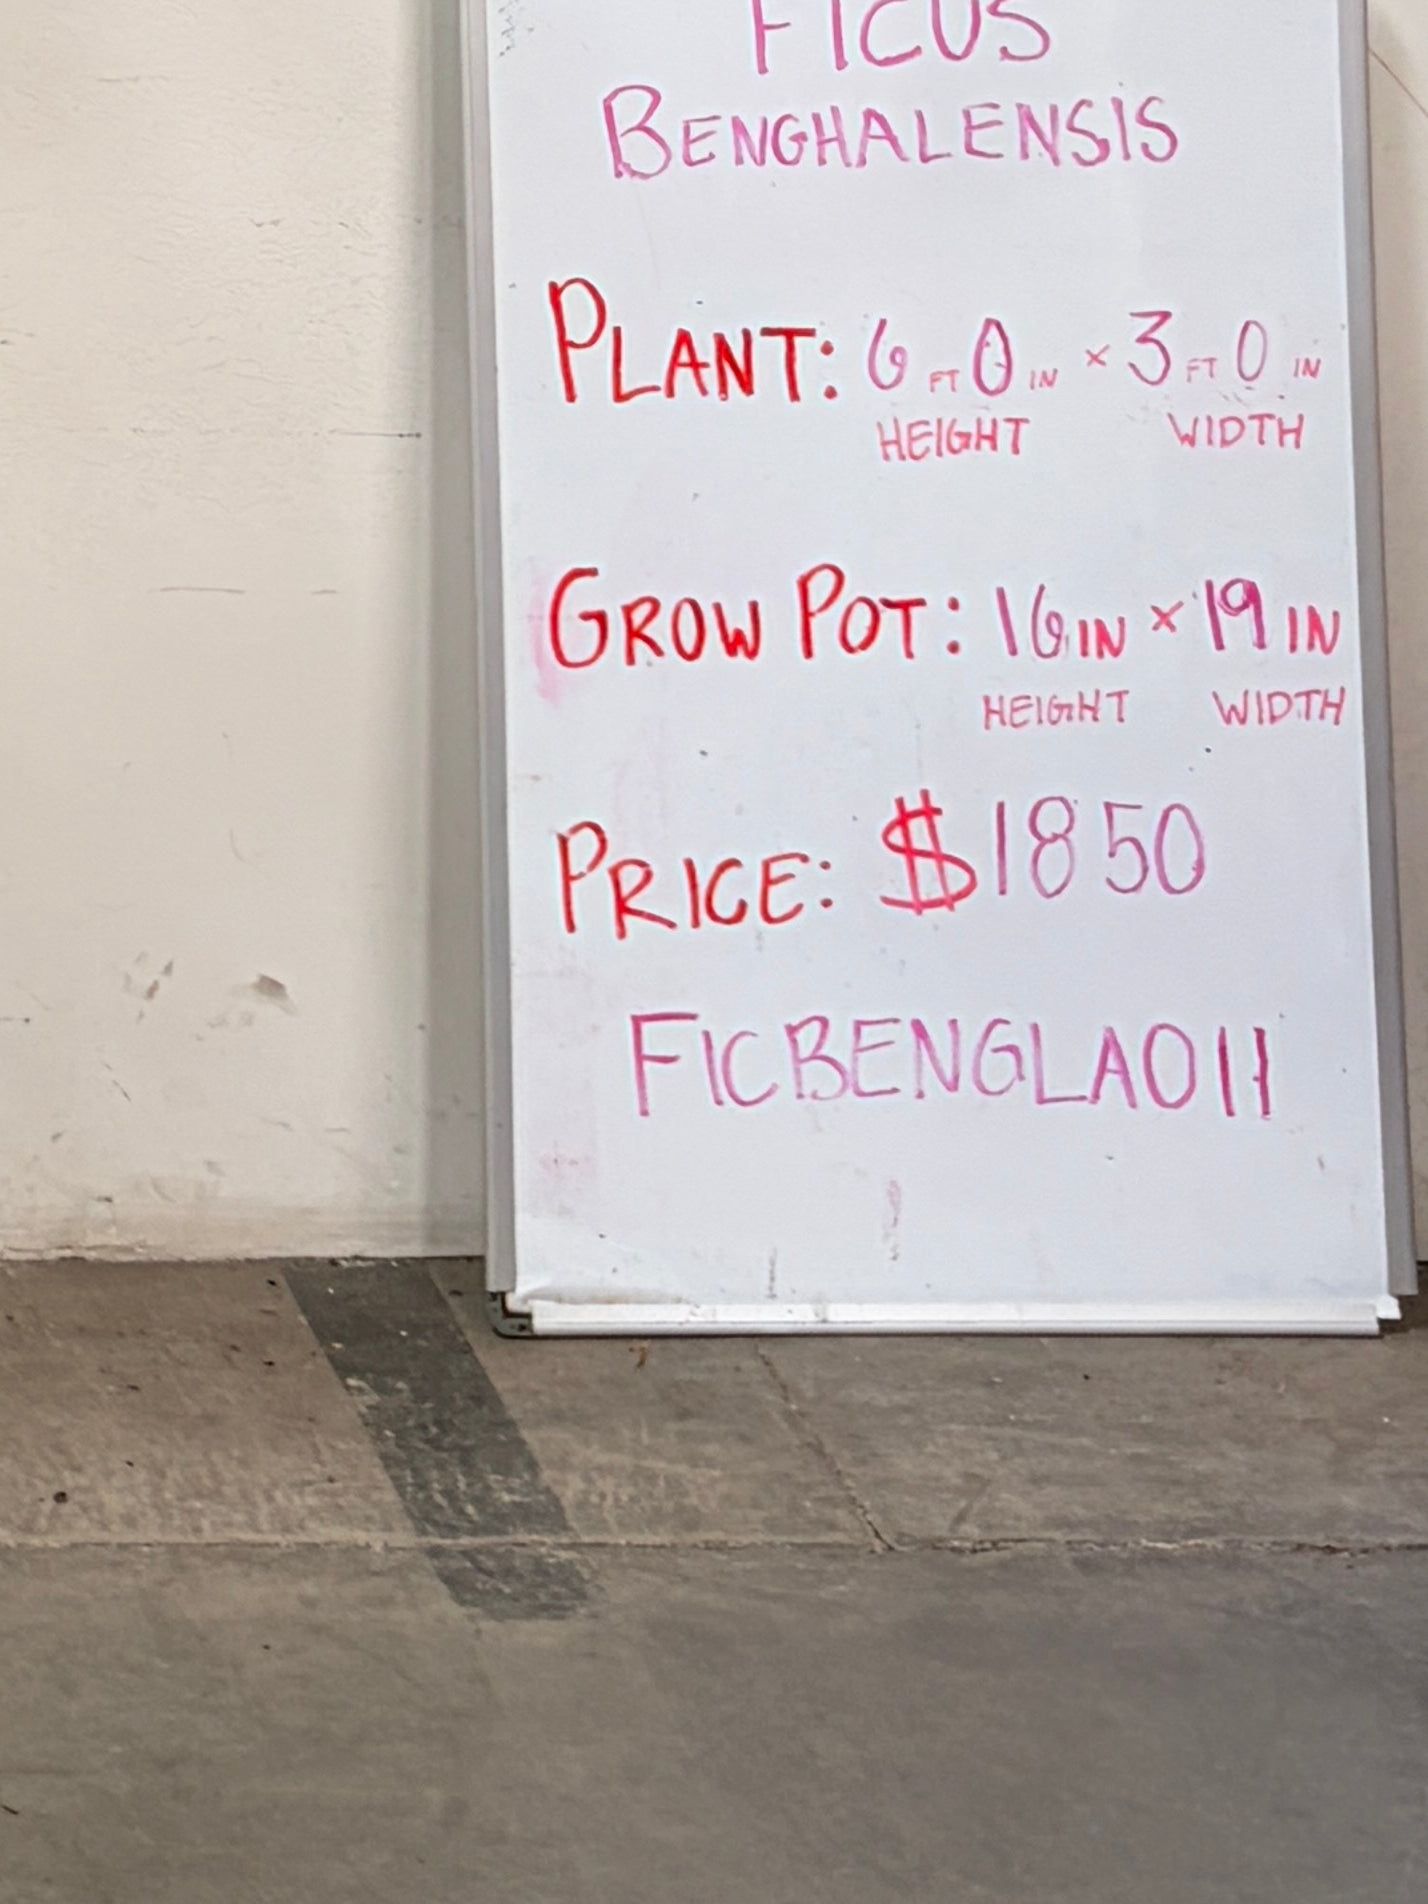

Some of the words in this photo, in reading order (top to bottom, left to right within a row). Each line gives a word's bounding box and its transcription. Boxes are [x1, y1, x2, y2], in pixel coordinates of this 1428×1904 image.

[601, 84, 1179, 181] BENGHALENSIS
[547, 277, 839, 405] PLANT:
[866, 318, 907, 392] 6
[927, 367, 959, 393] FT
[971, 317, 1014, 399] 0
[1128, 309, 1172, 387] 3
[1185, 356, 1217, 380] FT
[1235, 318, 1268, 384] 0
[879, 416, 1028, 463] HEIGHT
[1168, 412, 1305, 449] WIDTH
[545, 566, 763, 671] GROW
[795, 562, 961, 662] POT:
[981, 689, 1128, 730] HEIGHT
[1213, 687, 1346, 727] WIDTH
[556, 820, 833, 942] PRICE:
[879, 788, 1206, 918] $1850
